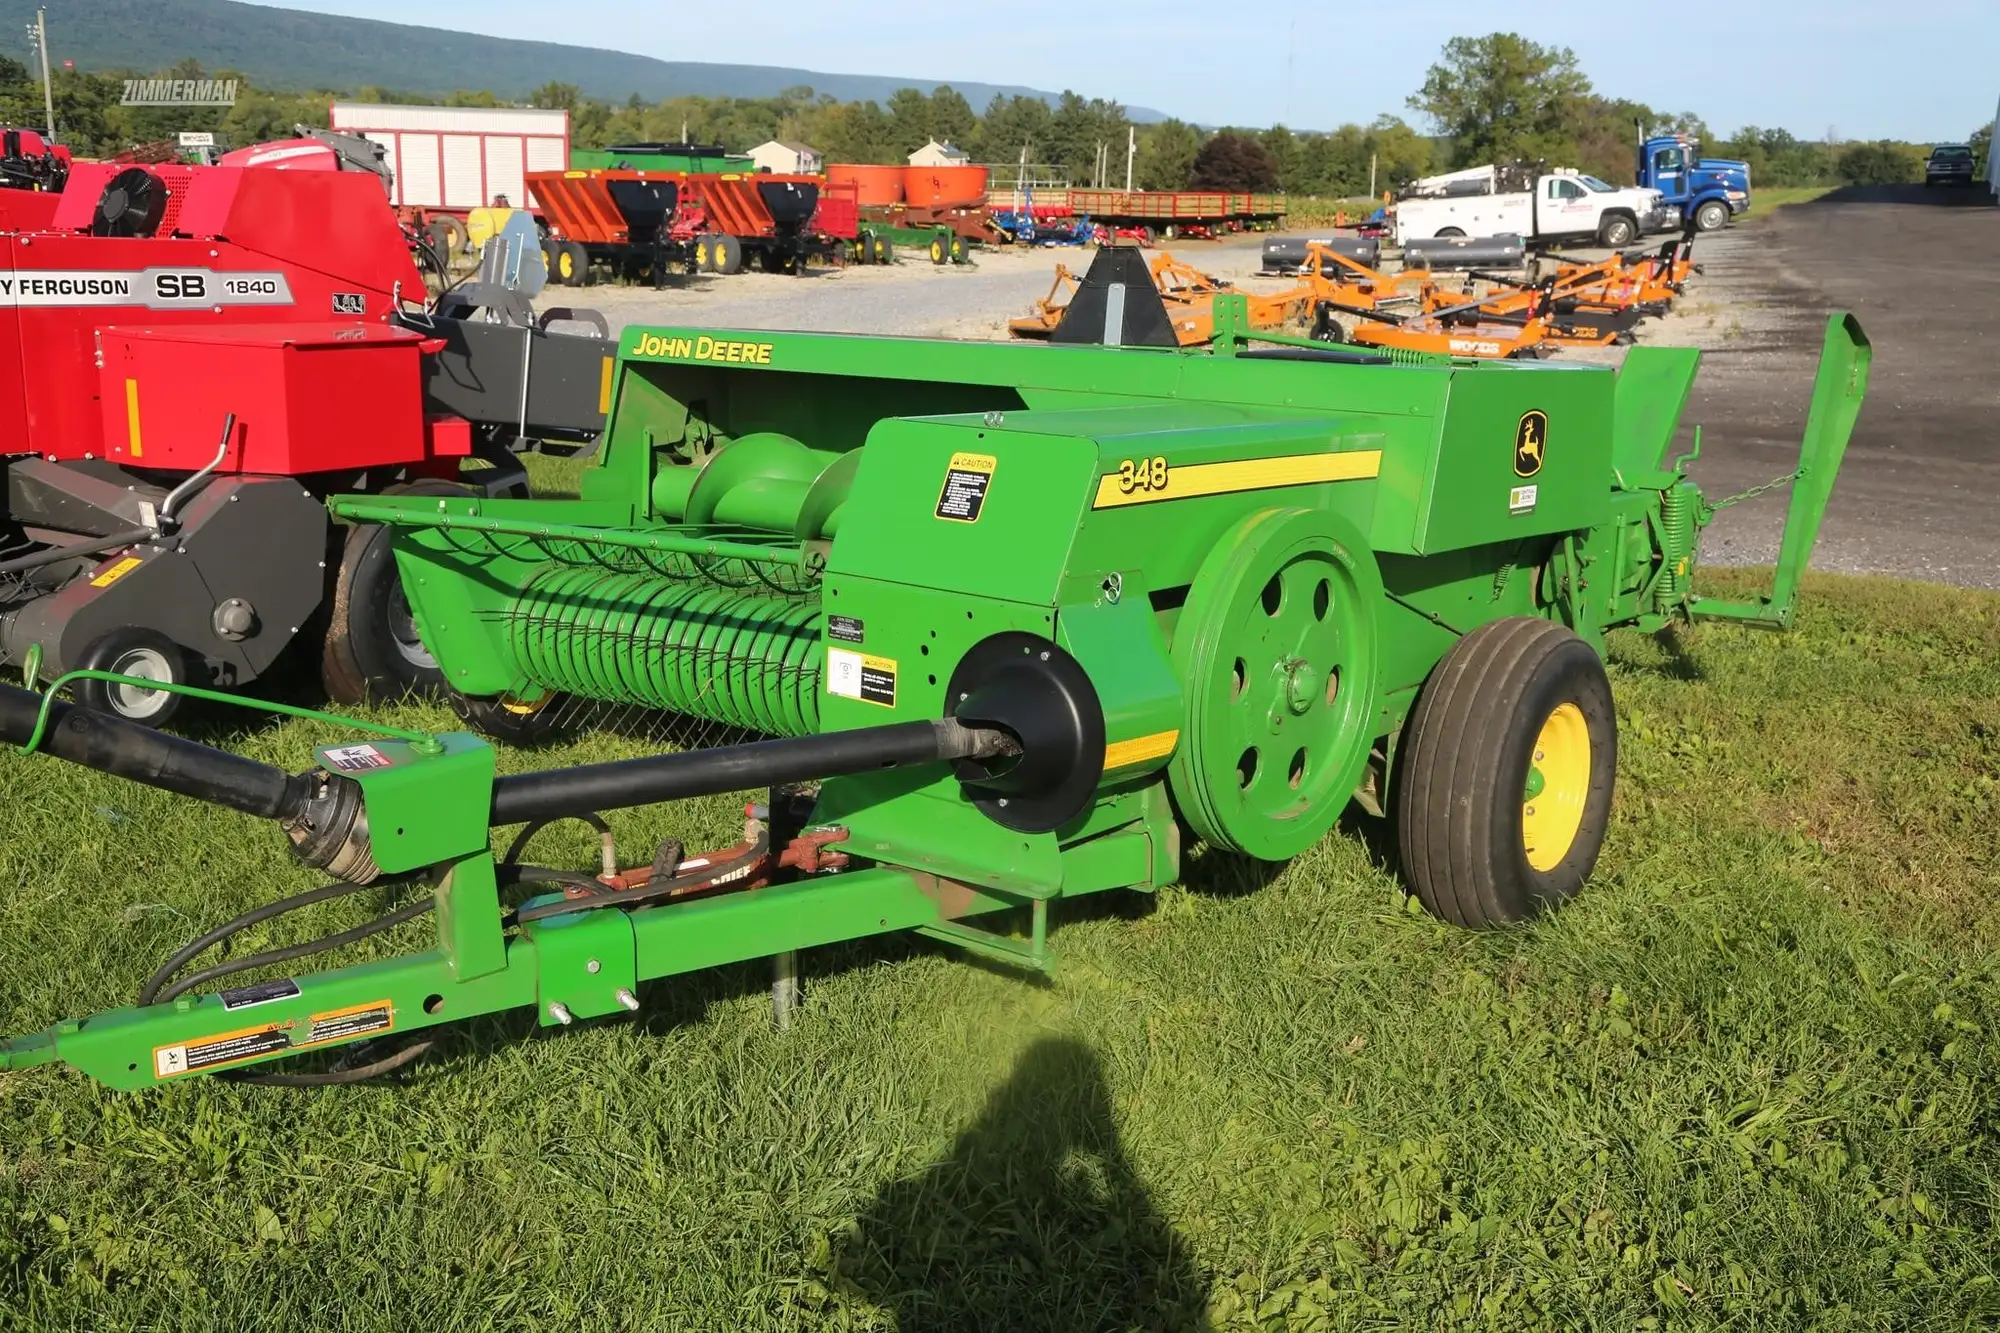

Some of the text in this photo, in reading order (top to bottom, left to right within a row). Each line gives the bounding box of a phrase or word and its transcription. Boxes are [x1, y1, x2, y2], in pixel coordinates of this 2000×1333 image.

[20, 278, 129, 296] FERGUSON
[156, 274, 206, 299] SB
[225, 280, 276, 294] 1840
[632, 333, 774, 364] JOHN DEERE
[1448, 339, 1500, 354] WOODS
[961, 458, 993, 468] CAUTION
[1119, 455, 1168, 495] 348
